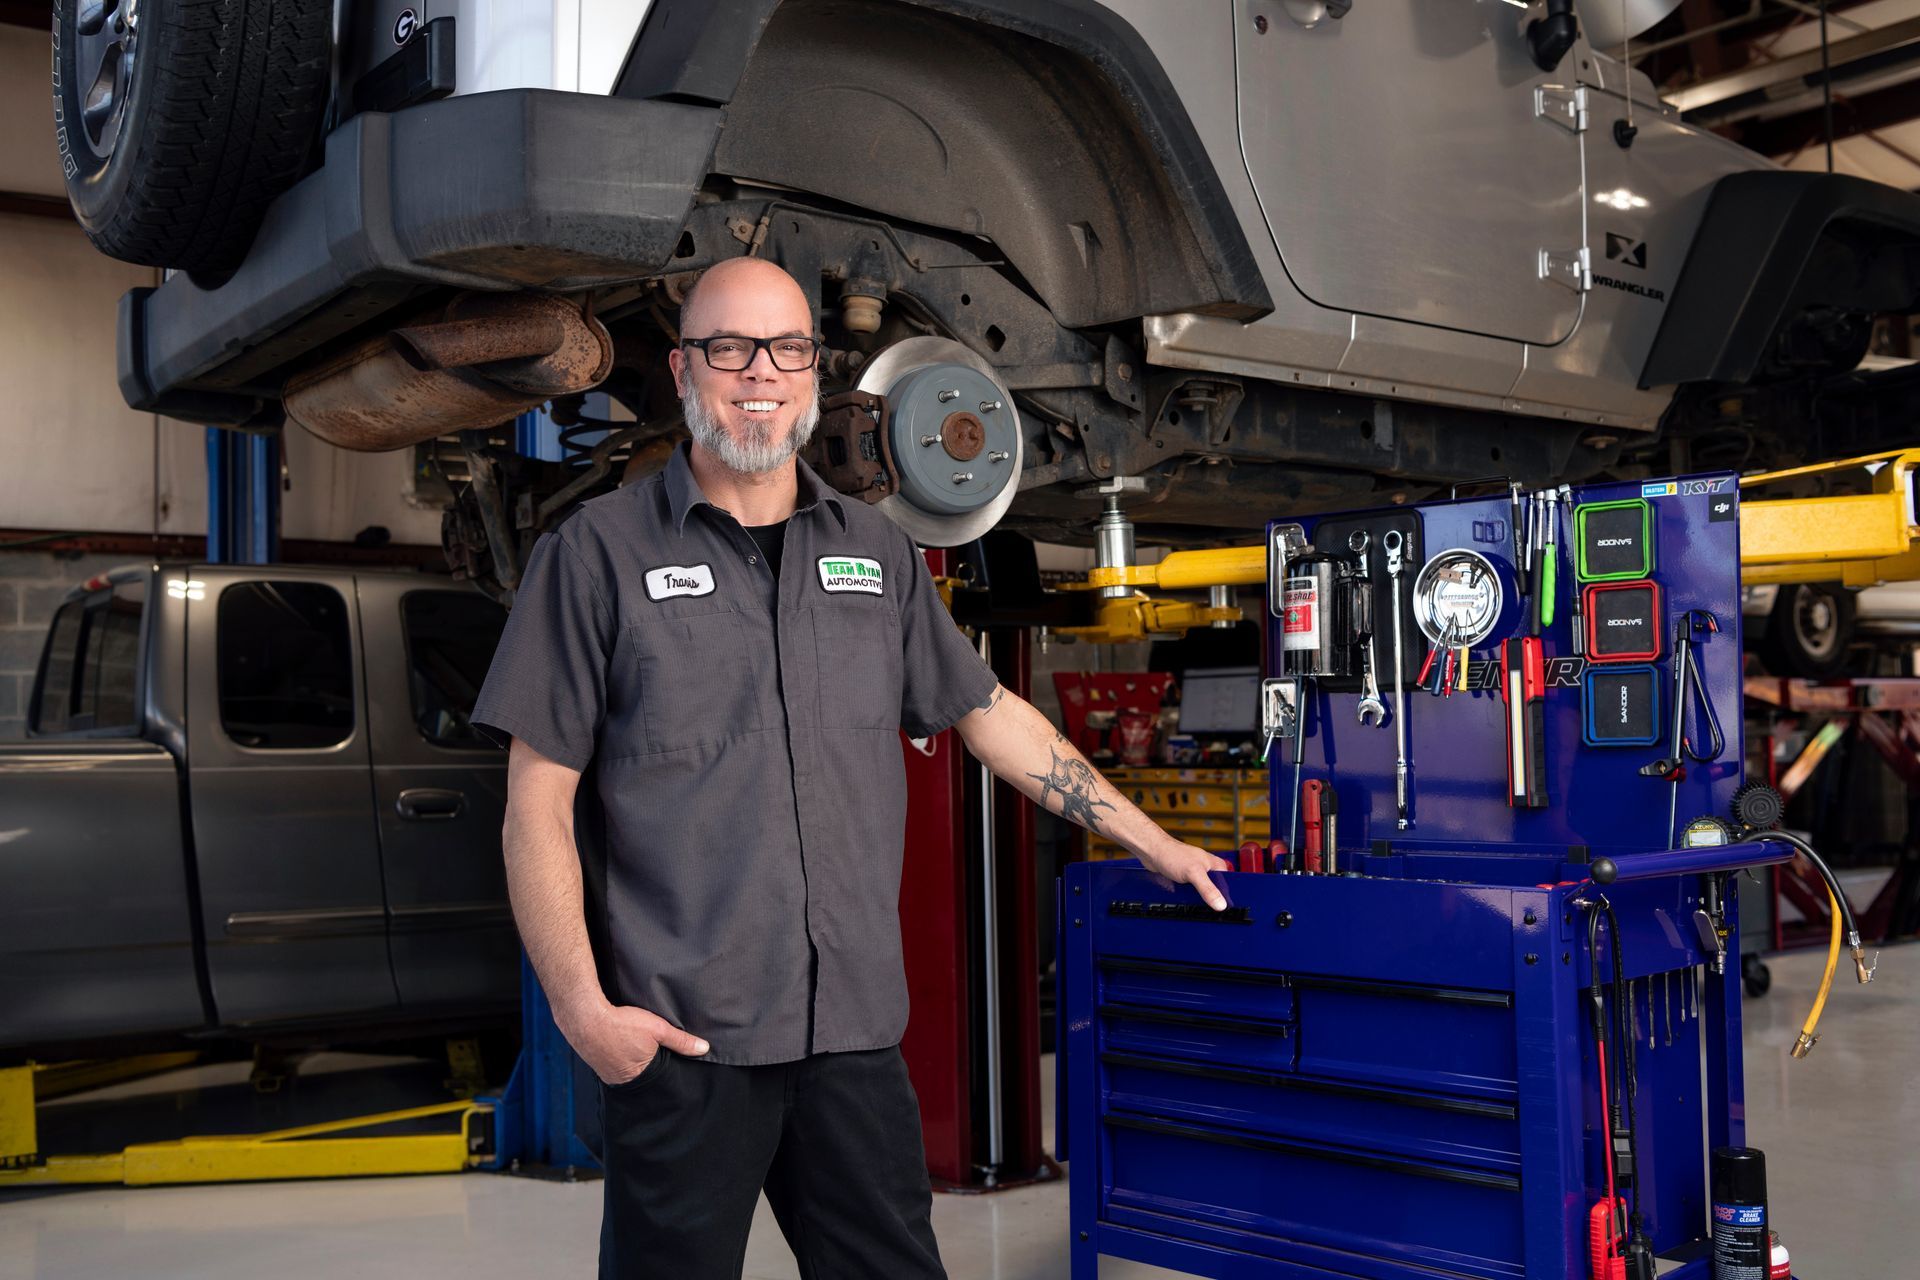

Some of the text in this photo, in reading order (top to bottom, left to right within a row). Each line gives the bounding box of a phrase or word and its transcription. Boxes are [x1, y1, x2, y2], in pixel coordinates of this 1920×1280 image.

[1592, 274, 1665, 303] WRANGLER
[1683, 479, 1732, 495] KYT
[663, 573, 700, 590] Travis
